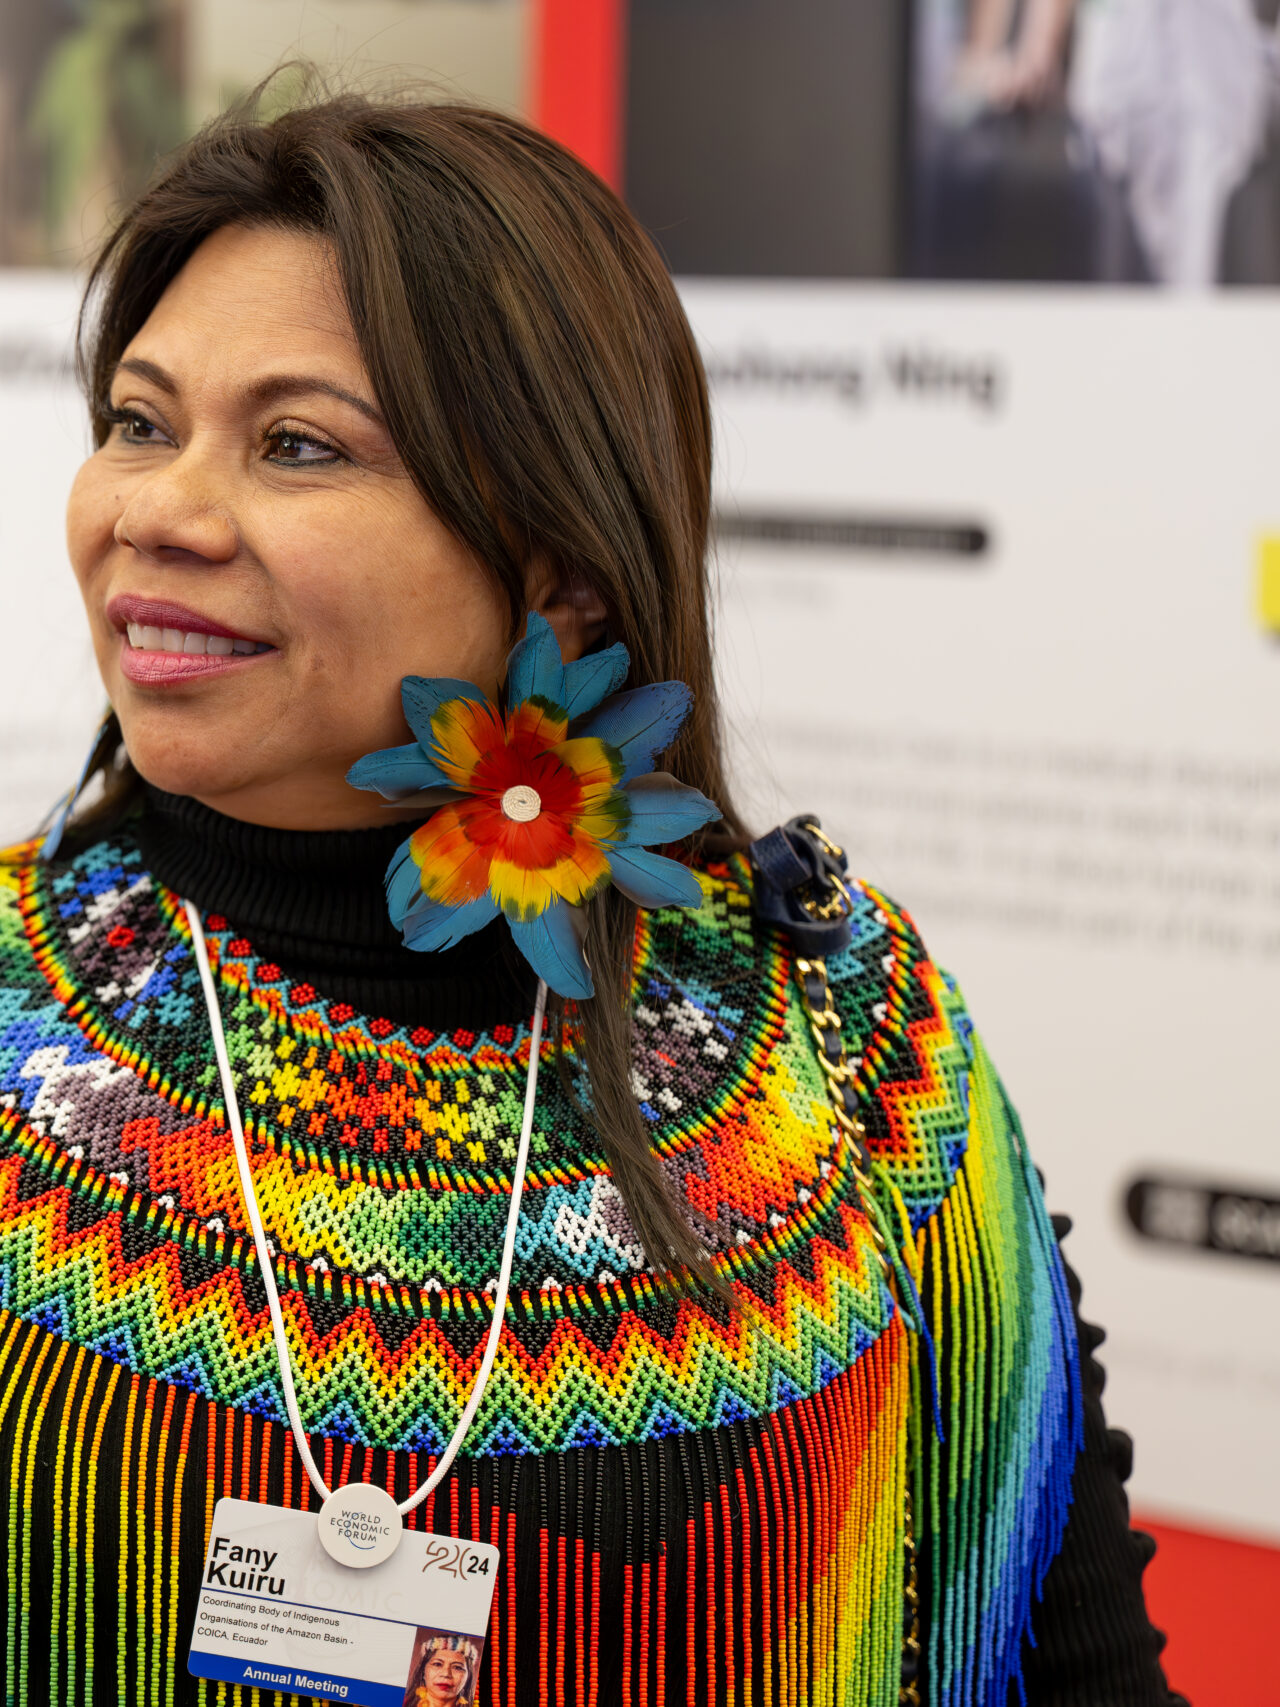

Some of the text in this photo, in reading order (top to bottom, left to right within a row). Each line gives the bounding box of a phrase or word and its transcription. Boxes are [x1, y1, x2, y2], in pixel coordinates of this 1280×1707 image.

[330, 1517, 390, 1536] ECONOMIC
[341, 1510, 381, 1524] WORLD
[338, 1528, 377, 1542] FORUM
[212, 1537, 278, 1572] Fany
[206, 1560, 286, 1596] Kuiru
[202, 1595, 340, 1627] Coordinating Body of Indigenous
[200, 1612, 259, 1630] Organisations
[260, 1622, 271, 1631] of
[271, 1623, 285, 1634] the
[286, 1627, 322, 1641] Amazon
[323, 1633, 348, 1645] Basin
[232, 1632, 269, 1646] Ecuador
[242, 1666, 349, 1698] Annual Meeting
